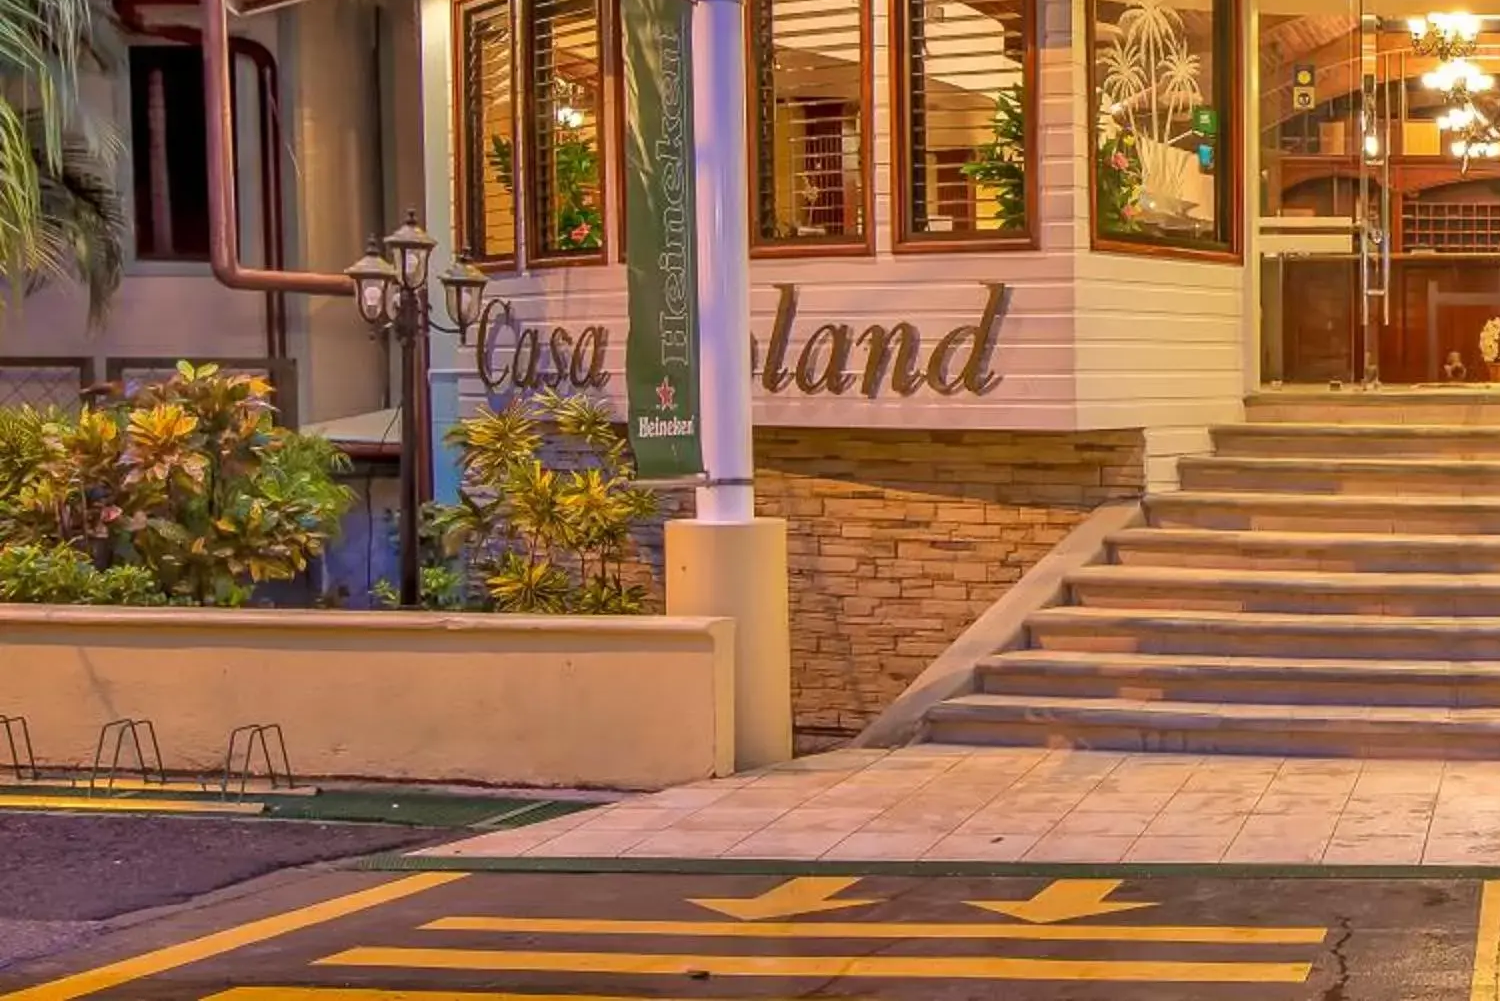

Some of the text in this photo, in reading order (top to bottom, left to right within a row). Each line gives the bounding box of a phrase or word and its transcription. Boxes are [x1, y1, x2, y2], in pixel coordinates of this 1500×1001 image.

[659, 29, 689, 367] Heineken
[476, 282, 1004, 396] Casa land
[638, 415, 695, 437] Heineken
